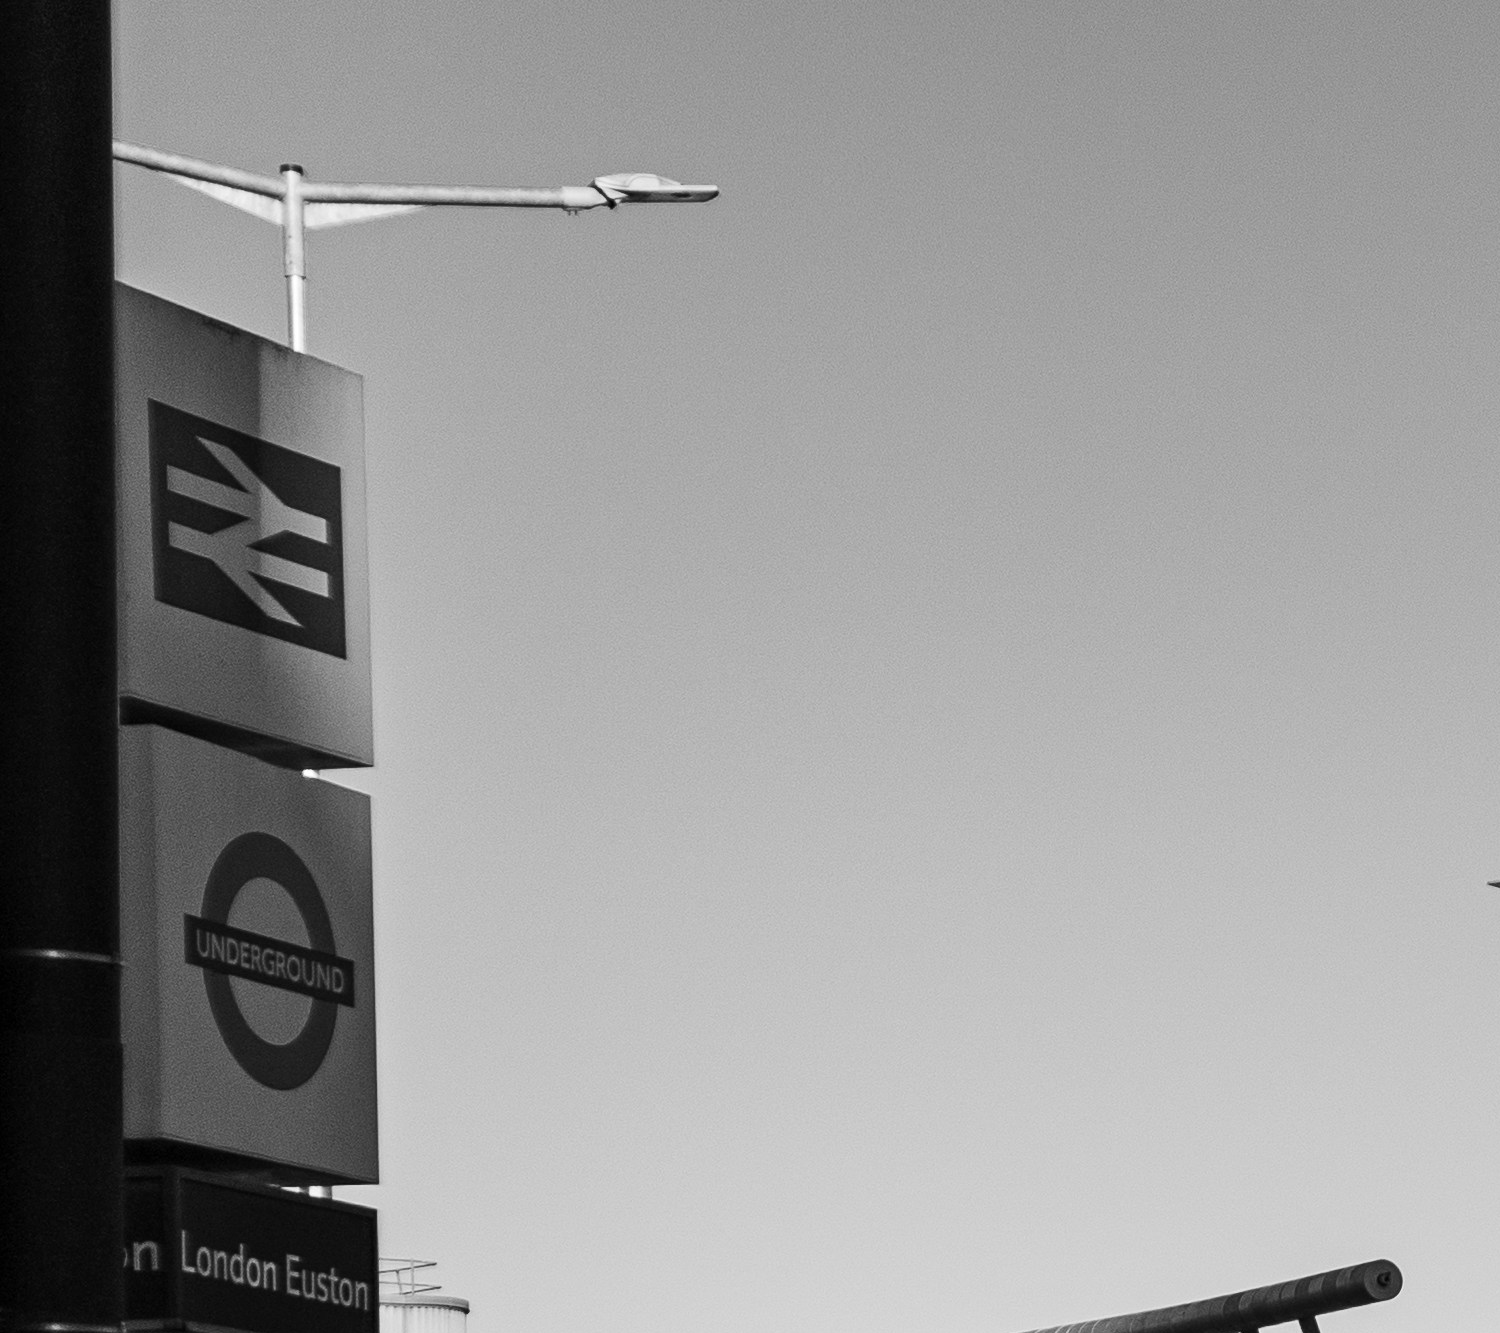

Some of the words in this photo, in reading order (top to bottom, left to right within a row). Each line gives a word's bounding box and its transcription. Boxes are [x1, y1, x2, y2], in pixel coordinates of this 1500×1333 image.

[195, 930, 345, 995] UNDERGROUND
[181, 1230, 277, 1291] London
[286, 1254, 369, 1312] Euston
